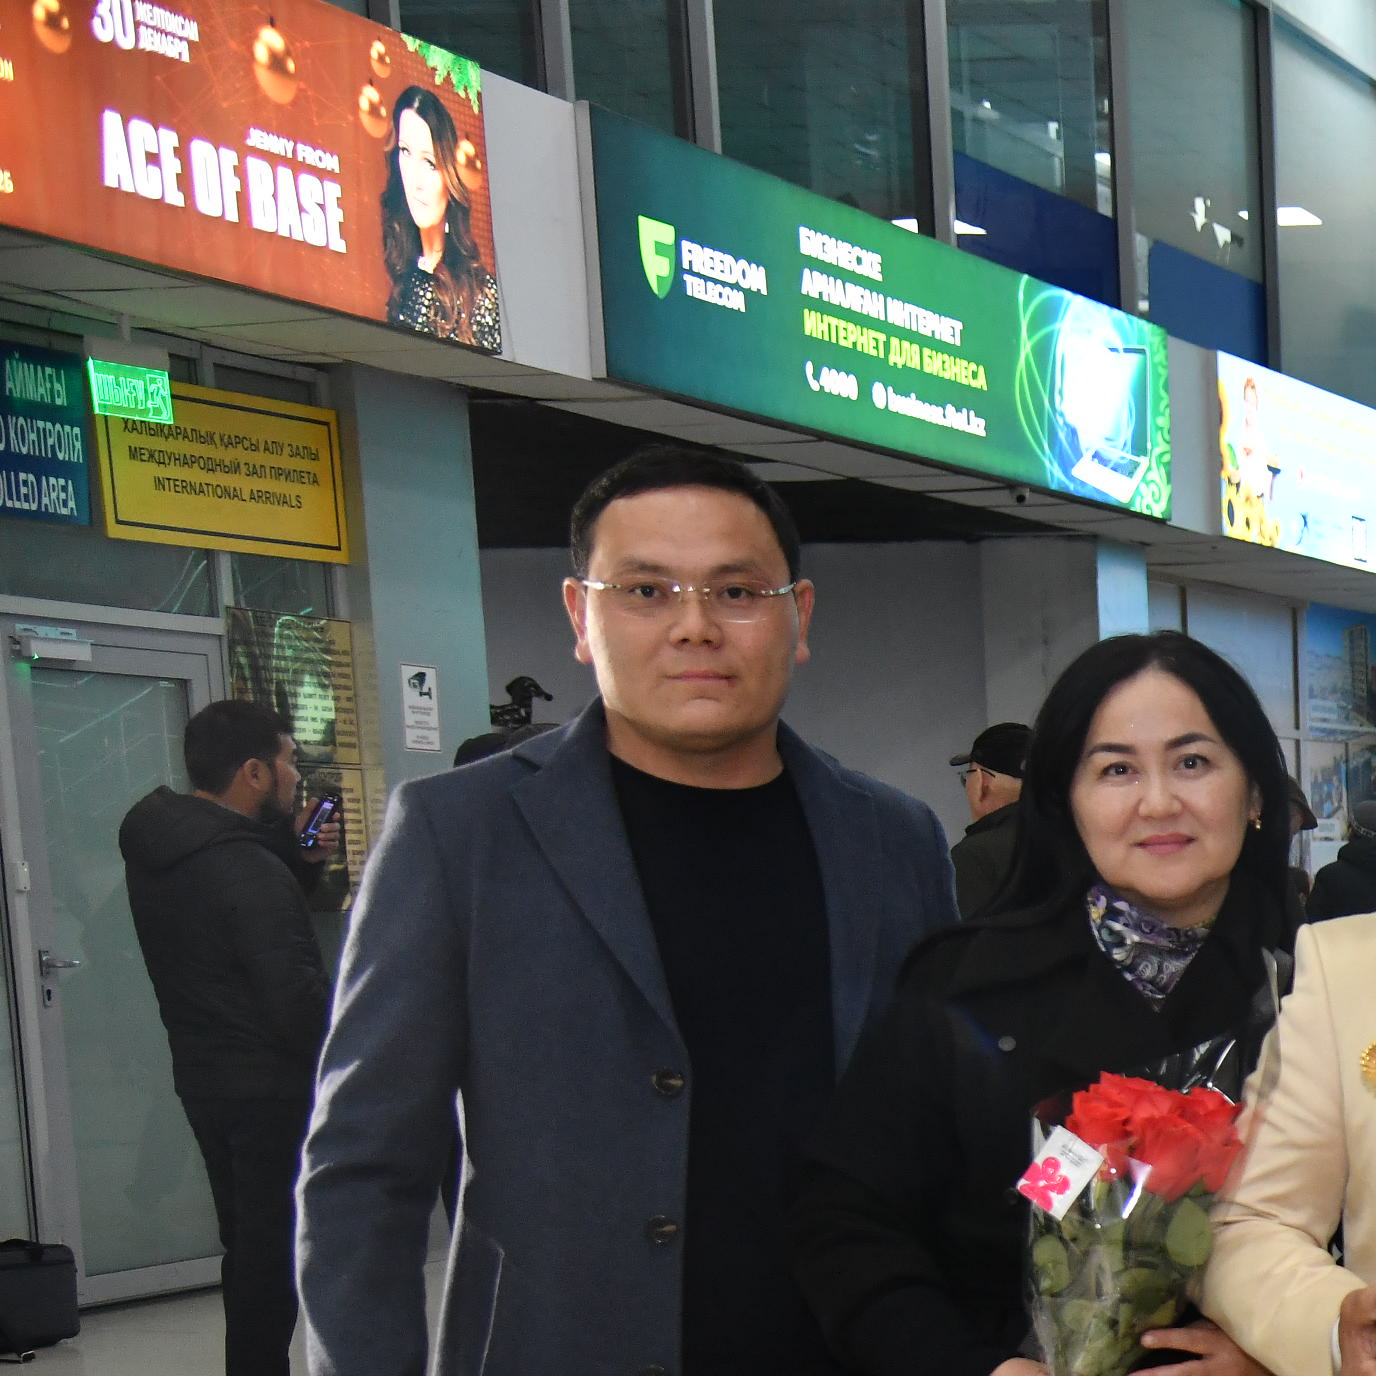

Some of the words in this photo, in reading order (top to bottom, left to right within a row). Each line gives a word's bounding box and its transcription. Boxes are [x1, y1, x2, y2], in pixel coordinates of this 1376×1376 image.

[246, 127, 294, 159] JENNY
[296, 142, 340, 174] FROM
[102, 109, 185, 208] ACE
[190, 138, 239, 223] OF
[246, 155, 347, 254] BASE
[680, 239, 767, 296] FREEDOM
[799, 226, 883, 282] БИЗНЕСКЕ
[683, 273, 746, 313] TELECOM
[886, 296, 963, 347] ИНТЕРНЕТ
[803, 308, 886, 359] ИНТЕРНЕТ
[888, 336, 921, 369] ДЛЯ
[922, 347, 988, 391] БИЗНЕСА
[5, 353, 67, 407] АЙМАҒЫ
[8, 415, 83, 464] КОНТРОЛЯ
[219, 434, 259, 452] ҚАРСЫ
[263, 440, 284, 457] АЛУ
[287, 443, 320, 462] ЗАЛЫ
[128, 445, 241, 475] МЕЖДУНАРОДНЫЙ
[243, 462, 266, 478] ЗАЛ
[269, 466, 320, 486] ПРИЛЕТА
[41, 476, 77, 517] AREA
[154, 476, 246, 502] INTERNATIONAL
[249, 489, 303, 509] ARRIVALS
